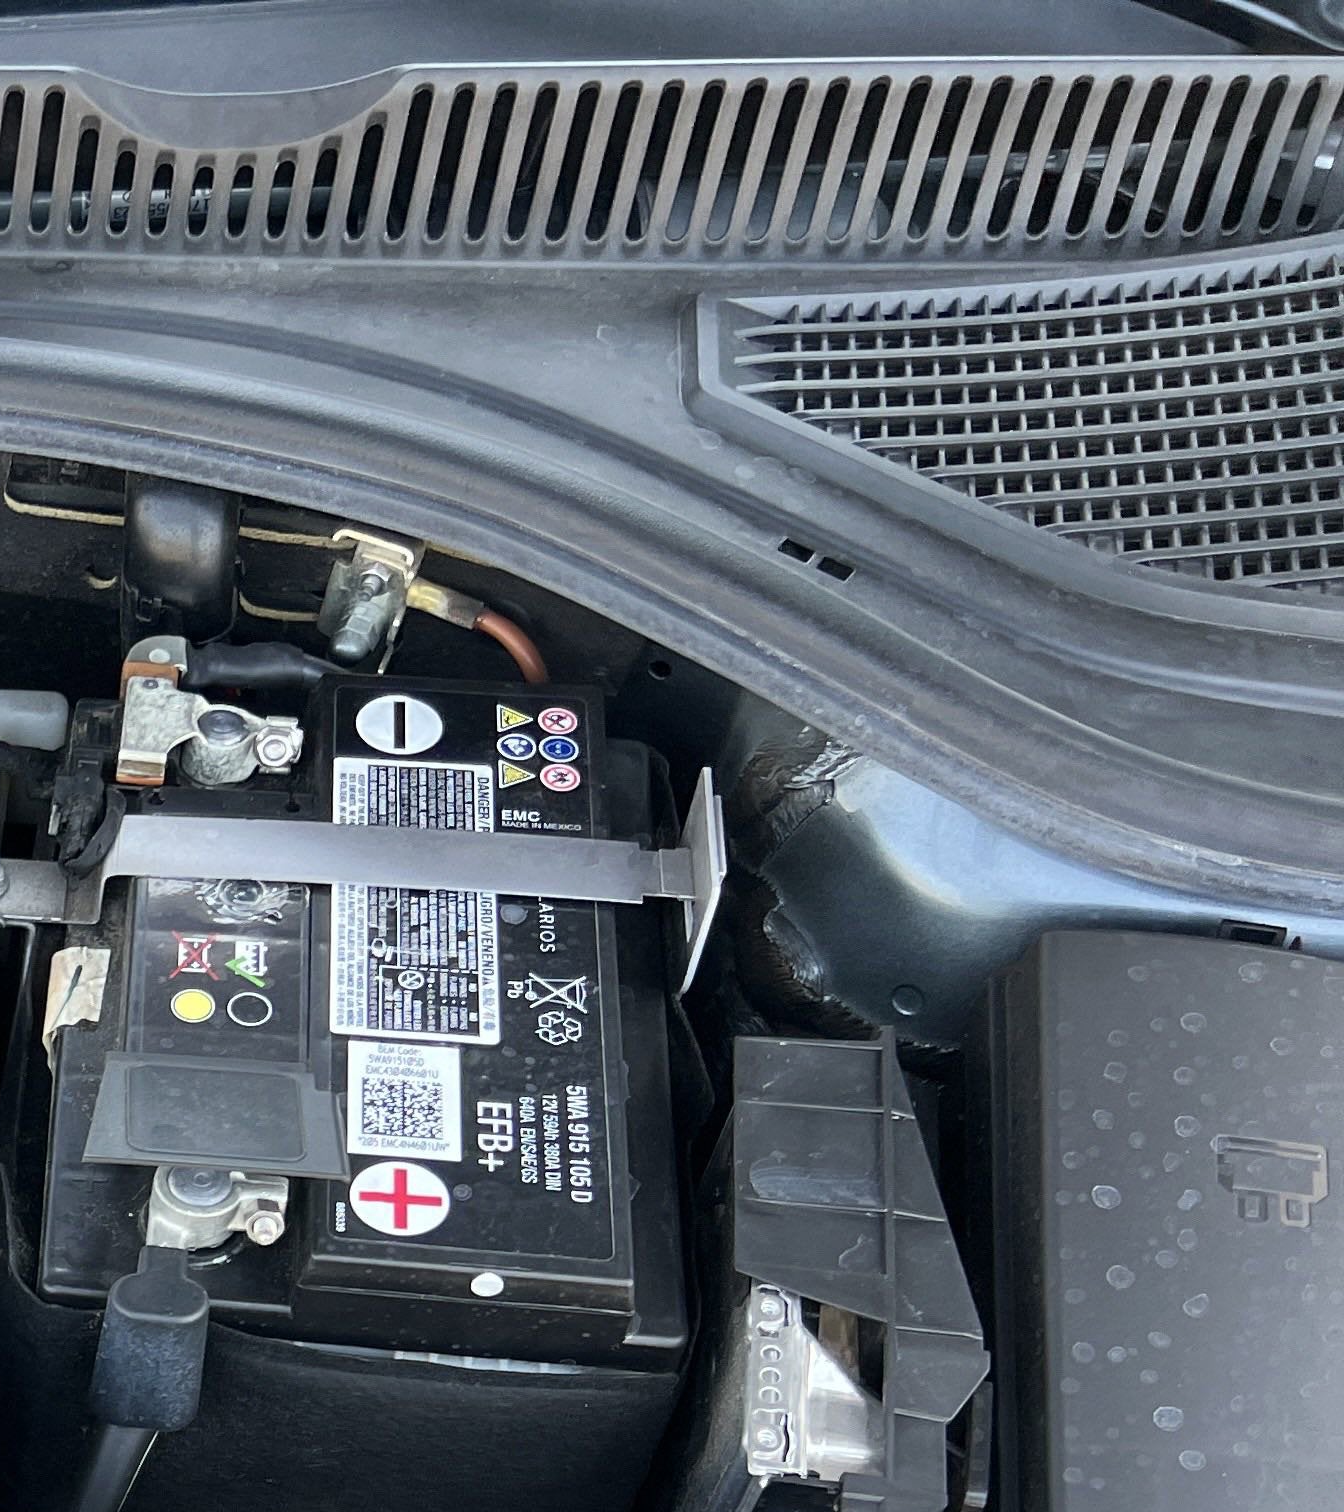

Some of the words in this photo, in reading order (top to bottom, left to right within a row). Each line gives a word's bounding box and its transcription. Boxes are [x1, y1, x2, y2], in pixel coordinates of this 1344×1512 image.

[501, 809, 540, 822] EMC
[501, 820, 529, 828] MADE
[543, 822, 581, 831] MEXICO
[505, 981, 523, 997] Pb
[540, 1094, 558, 1112] 12V
[564, 1086, 588, 1118] 5WA
[476, 1101, 514, 1171] EFB+
[566, 1124, 590, 1151] 915
[542, 1143, 560, 1168] 380A
[568, 1158, 592, 1185] 105
[543, 1172, 561, 1190] DIN
[569, 1191, 592, 1202] D
